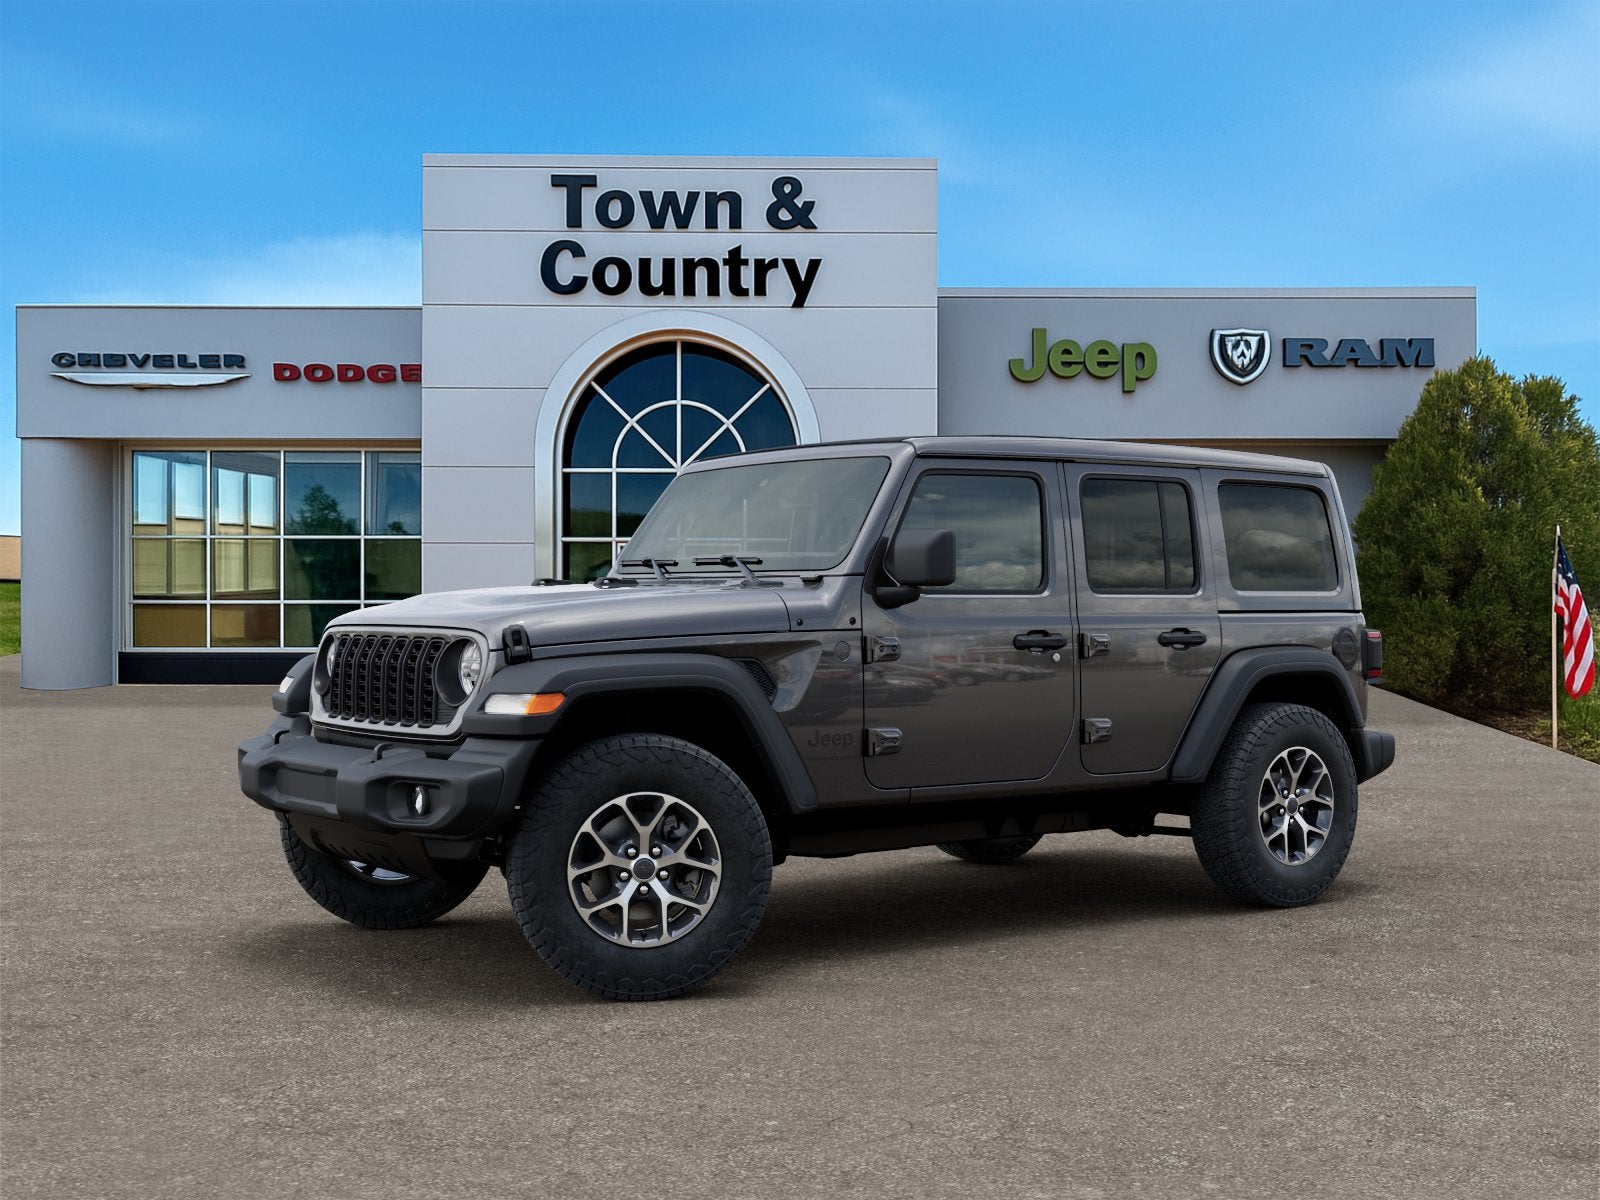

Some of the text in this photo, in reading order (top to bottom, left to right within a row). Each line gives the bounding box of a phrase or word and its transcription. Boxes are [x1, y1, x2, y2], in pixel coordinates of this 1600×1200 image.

[550, 174, 818, 230] Town &
[540, 239, 822, 308] Country
[272, 362, 422, 384] DODGE
[1008, 328, 1158, 393] Jeep
[1282, 337, 1436, 368] RAM
[807, 729, 854, 750] Jeep
